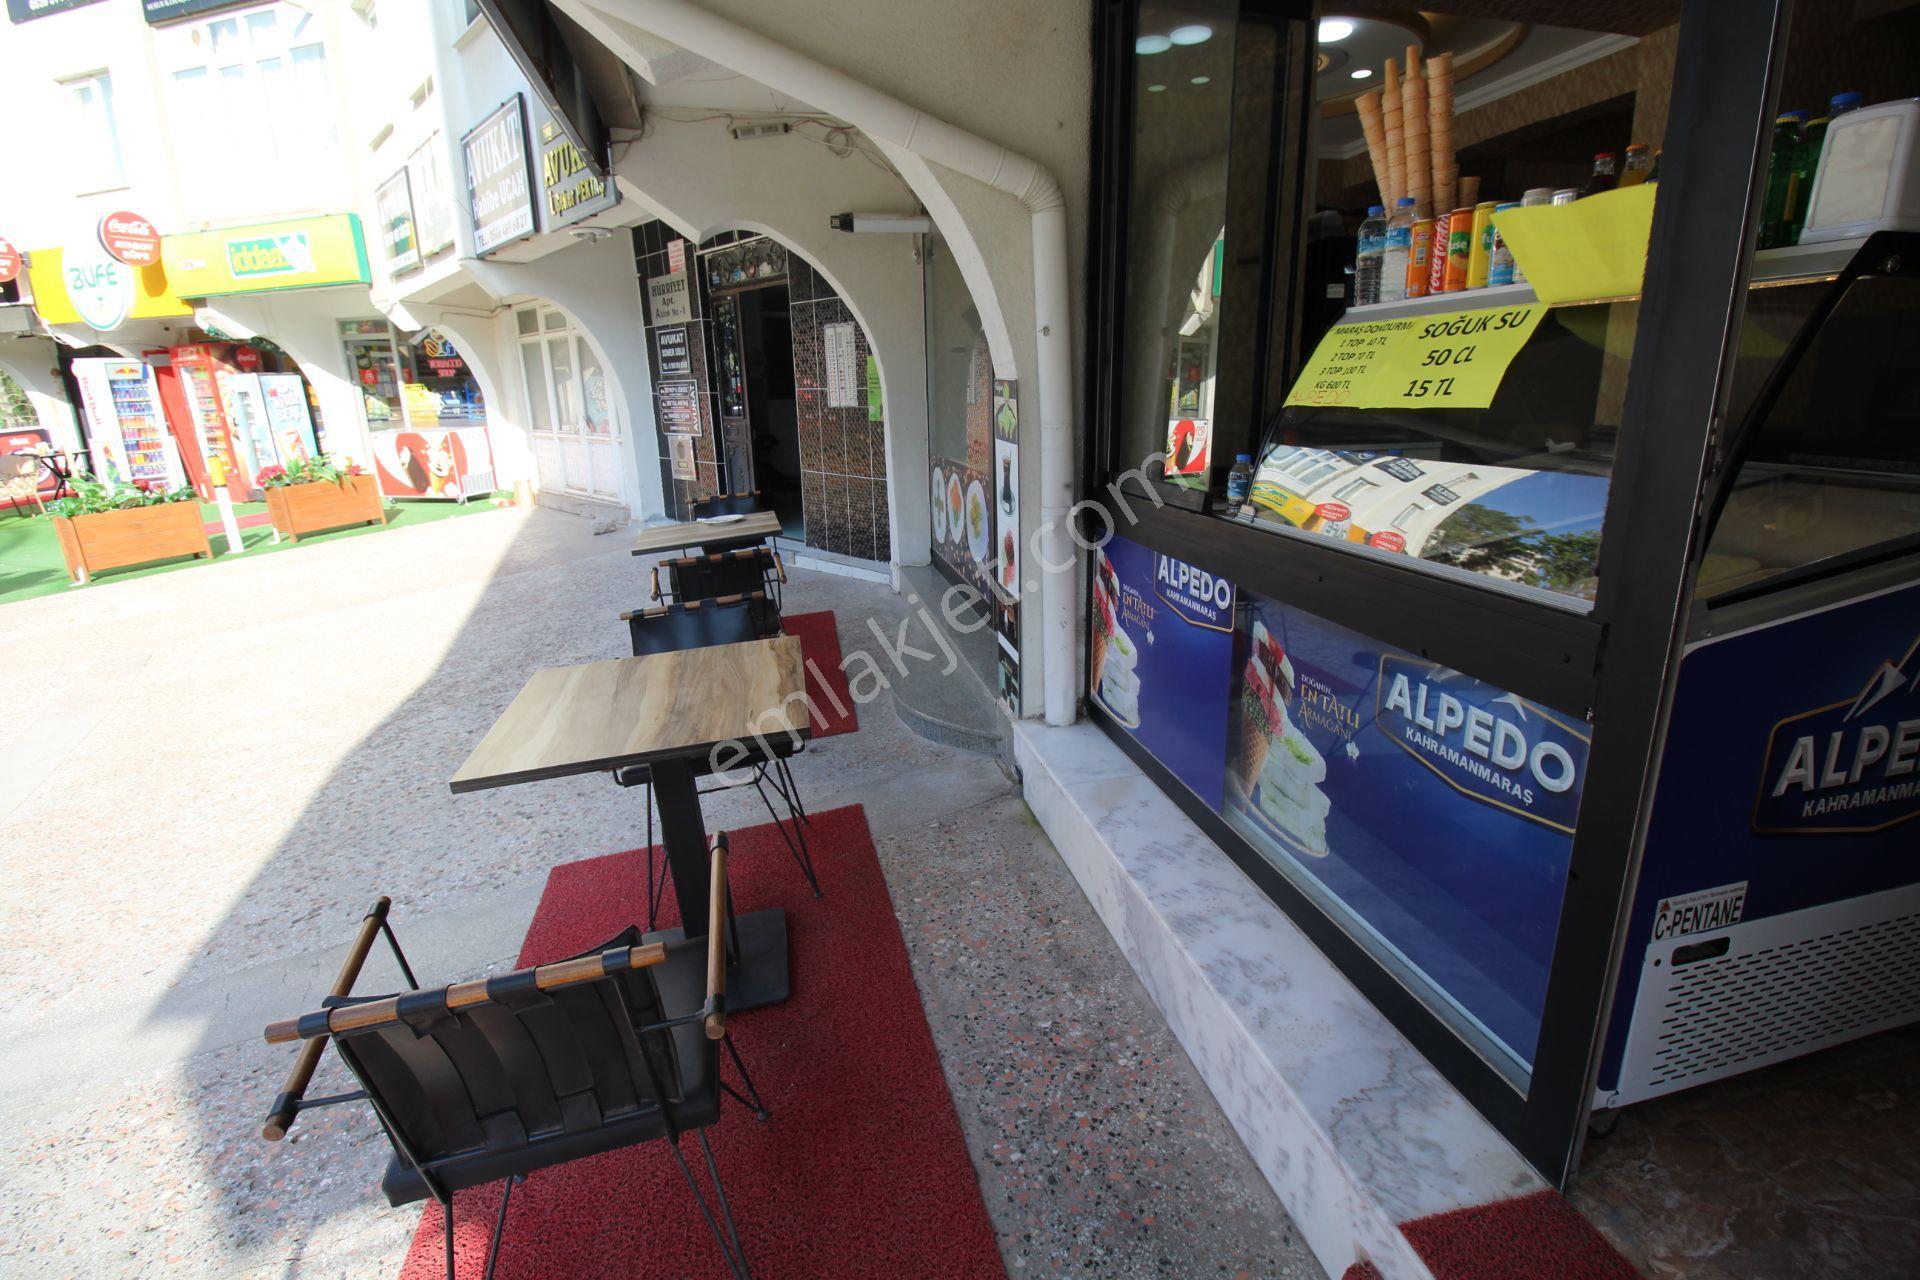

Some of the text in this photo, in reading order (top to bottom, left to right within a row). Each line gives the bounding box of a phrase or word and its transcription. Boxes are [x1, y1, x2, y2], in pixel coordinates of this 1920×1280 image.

[466, 111, 520, 190] AVUKAT
[1449, 240, 1467, 250] use
[651, 279, 686, 297] HÜRRİYET
[1418, 309, 1531, 339] SOĞUK SU
[660, 333, 684, 346] AVUKAT
[1346, 338, 1365, 347] TOP
[1377, 336, 1388, 346] TL
[1330, 353, 1338, 361] 2
[1337, 352, 1356, 361] TOP
[1365, 351, 1376, 360] TL
[1421, 345, 1477, 366] 50 CL
[1325, 366, 1342, 375] TOP
[1358, 365, 1367, 374] TL
[1341, 380, 1351, 389] TL
[1403, 377, 1455, 397] 15 TL
[689, 384, 699, 432] AVUKAT
[1157, 554, 1231, 610] ALPEDO
[1122, 592, 1132, 604] EN
[1166, 588, 1217, 622] KAHRAMANMARAŞ
[1301, 683, 1360, 729] EN TATLI
[1384, 672, 1576, 793] ALPEDO
[1405, 726, 1534, 807] KAHRAMANMARAŞ
[1771, 719, 1920, 797] ALPE
[1654, 896, 1743, 941] C-PENTANE
